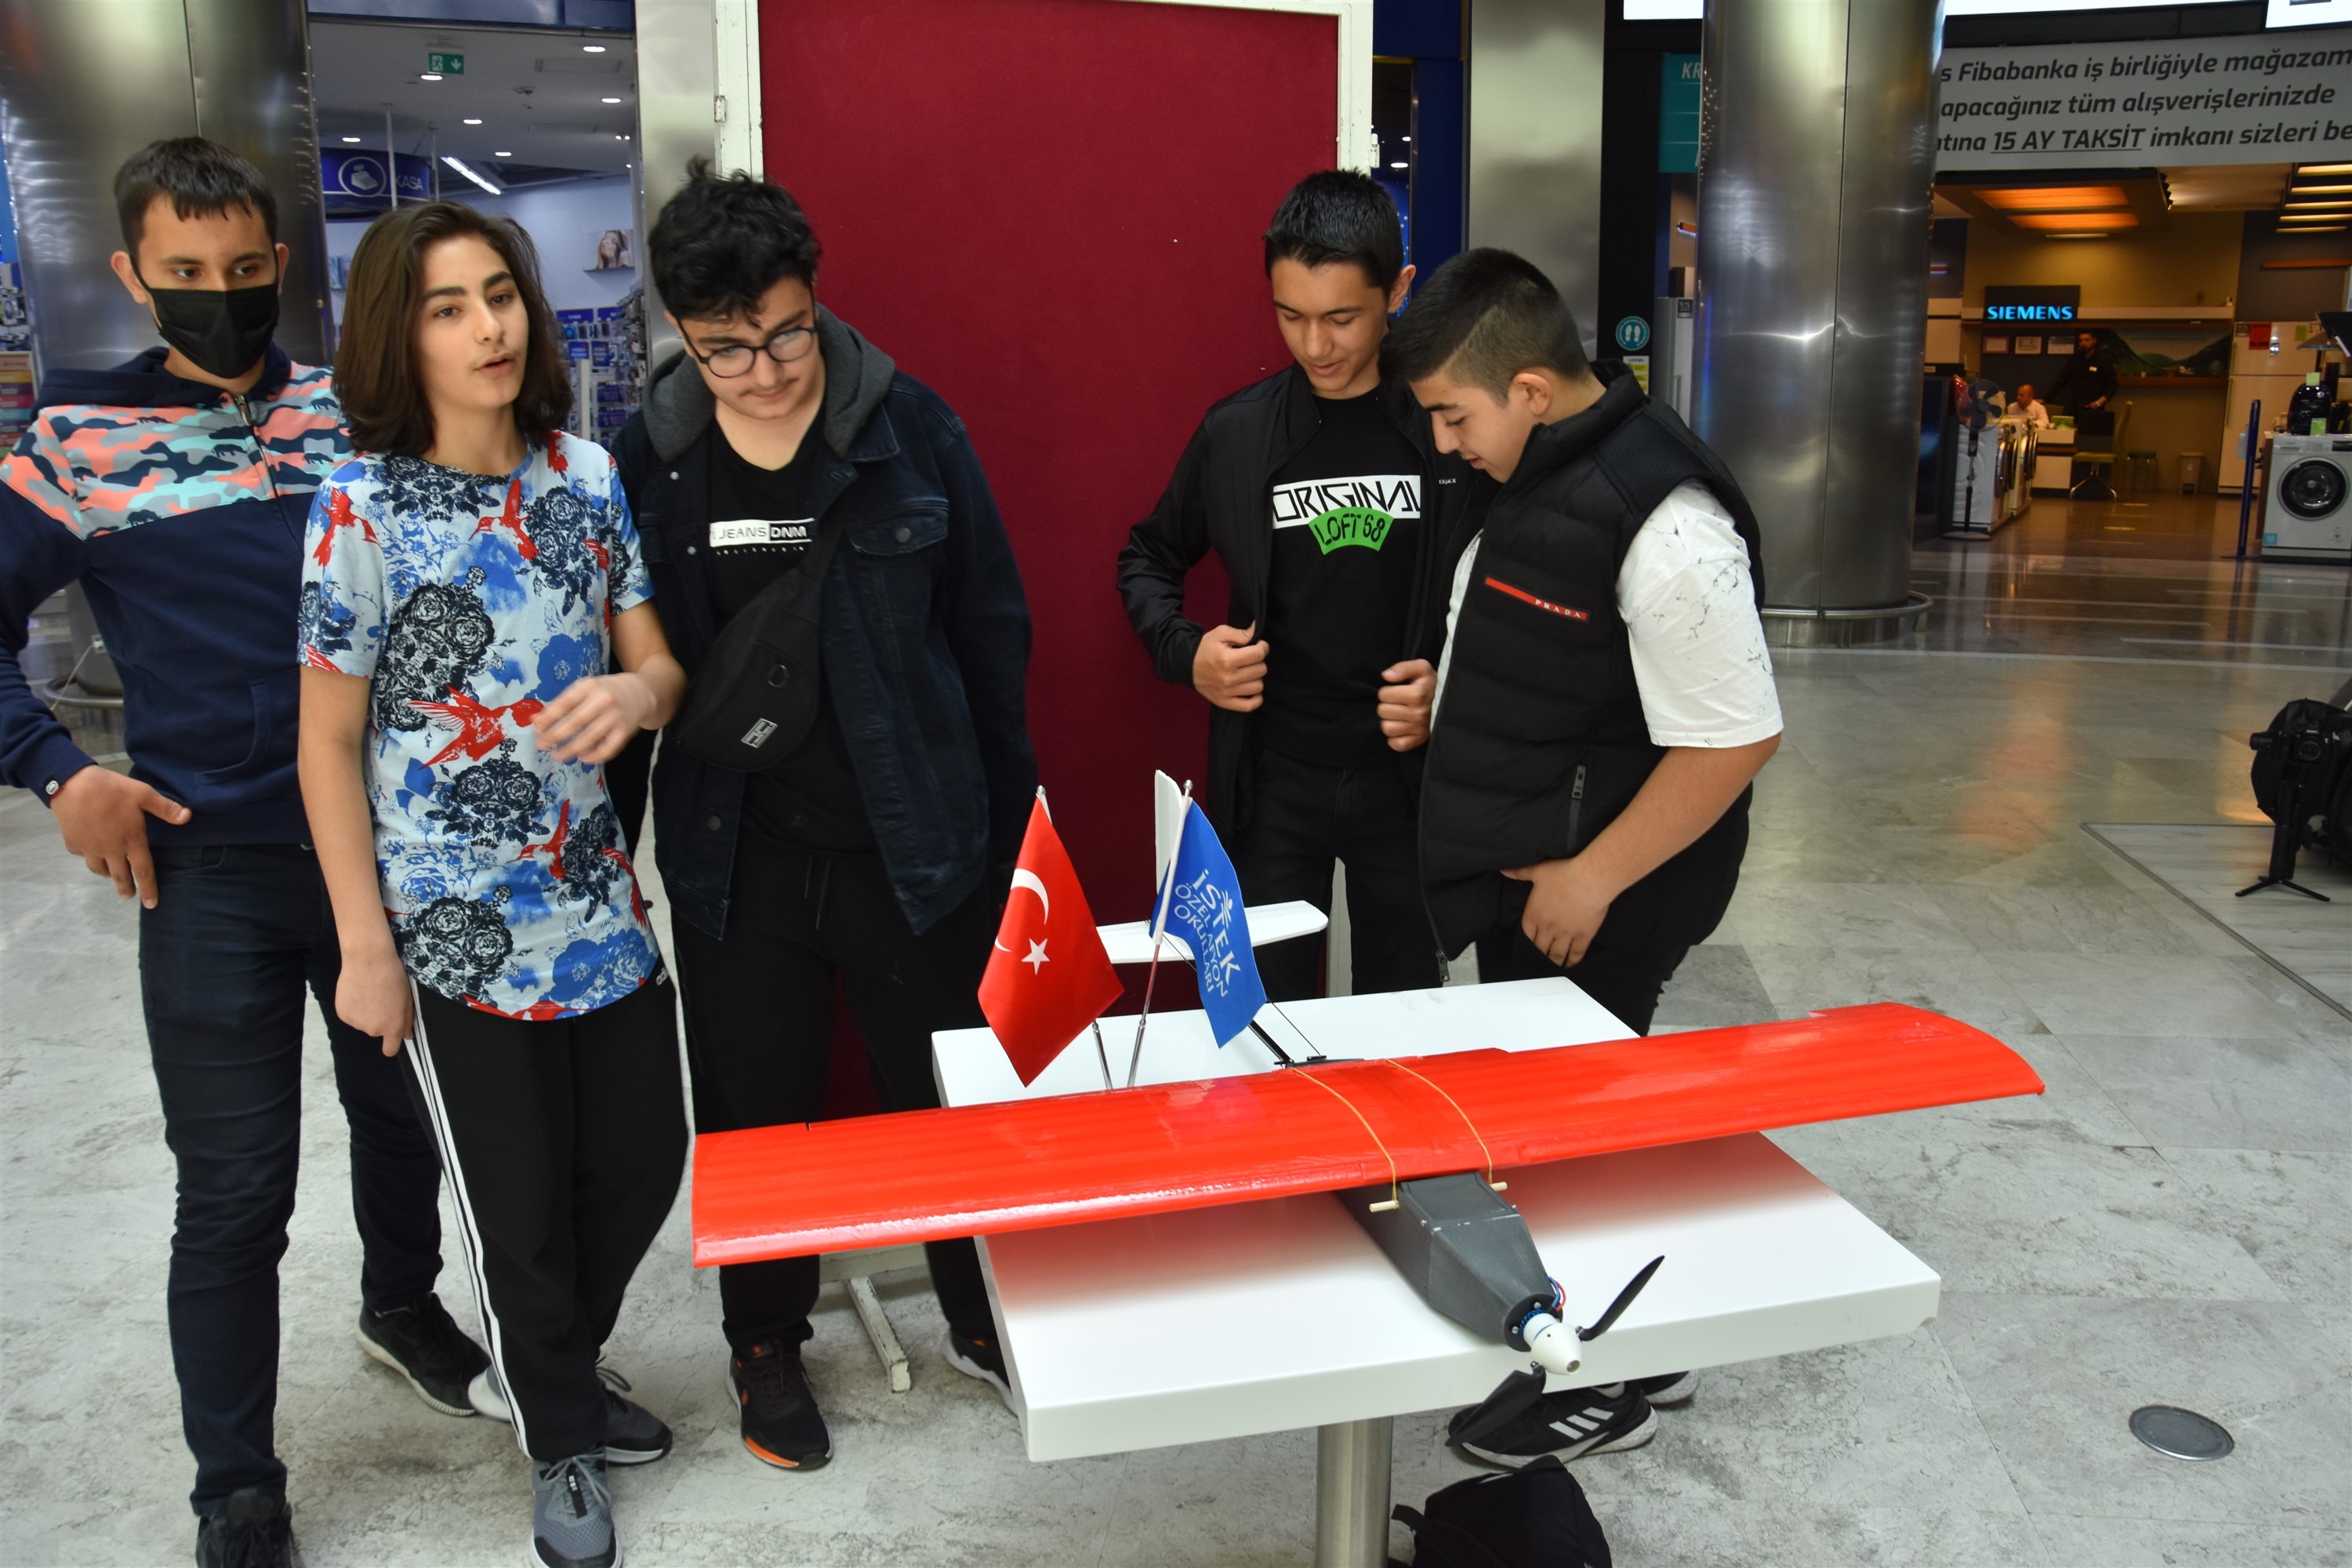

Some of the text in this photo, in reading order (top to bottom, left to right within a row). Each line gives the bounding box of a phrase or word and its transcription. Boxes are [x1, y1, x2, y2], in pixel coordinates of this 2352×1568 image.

[1958, 59, 2078, 82] Fibabanka
[2084, 57, 2103, 82] iş
[2110, 53, 2217, 80] birliğiyle
[1940, 83, 2336, 122] apacağınız tüm alışverişlerinizde
[1994, 132, 2017, 151] 15
[2021, 130, 2056, 150] AY
[2061, 124, 2147, 149] TAKSİT
[2150, 126, 2233, 147] imkanı
[2239, 120, 2319, 145] sizleri
[1987, 306, 2073, 320] SIEMENS
[718, 527, 767, 539] JEANS
[771, 526, 807, 539] DNM
[1314, 513, 1385, 546] LOFT 68
[1535, 598, 1581, 619] PRADA
[1174, 882, 1229, 997] ÖZEL AFYON
[1174, 904, 1214, 993] OKULLARI
